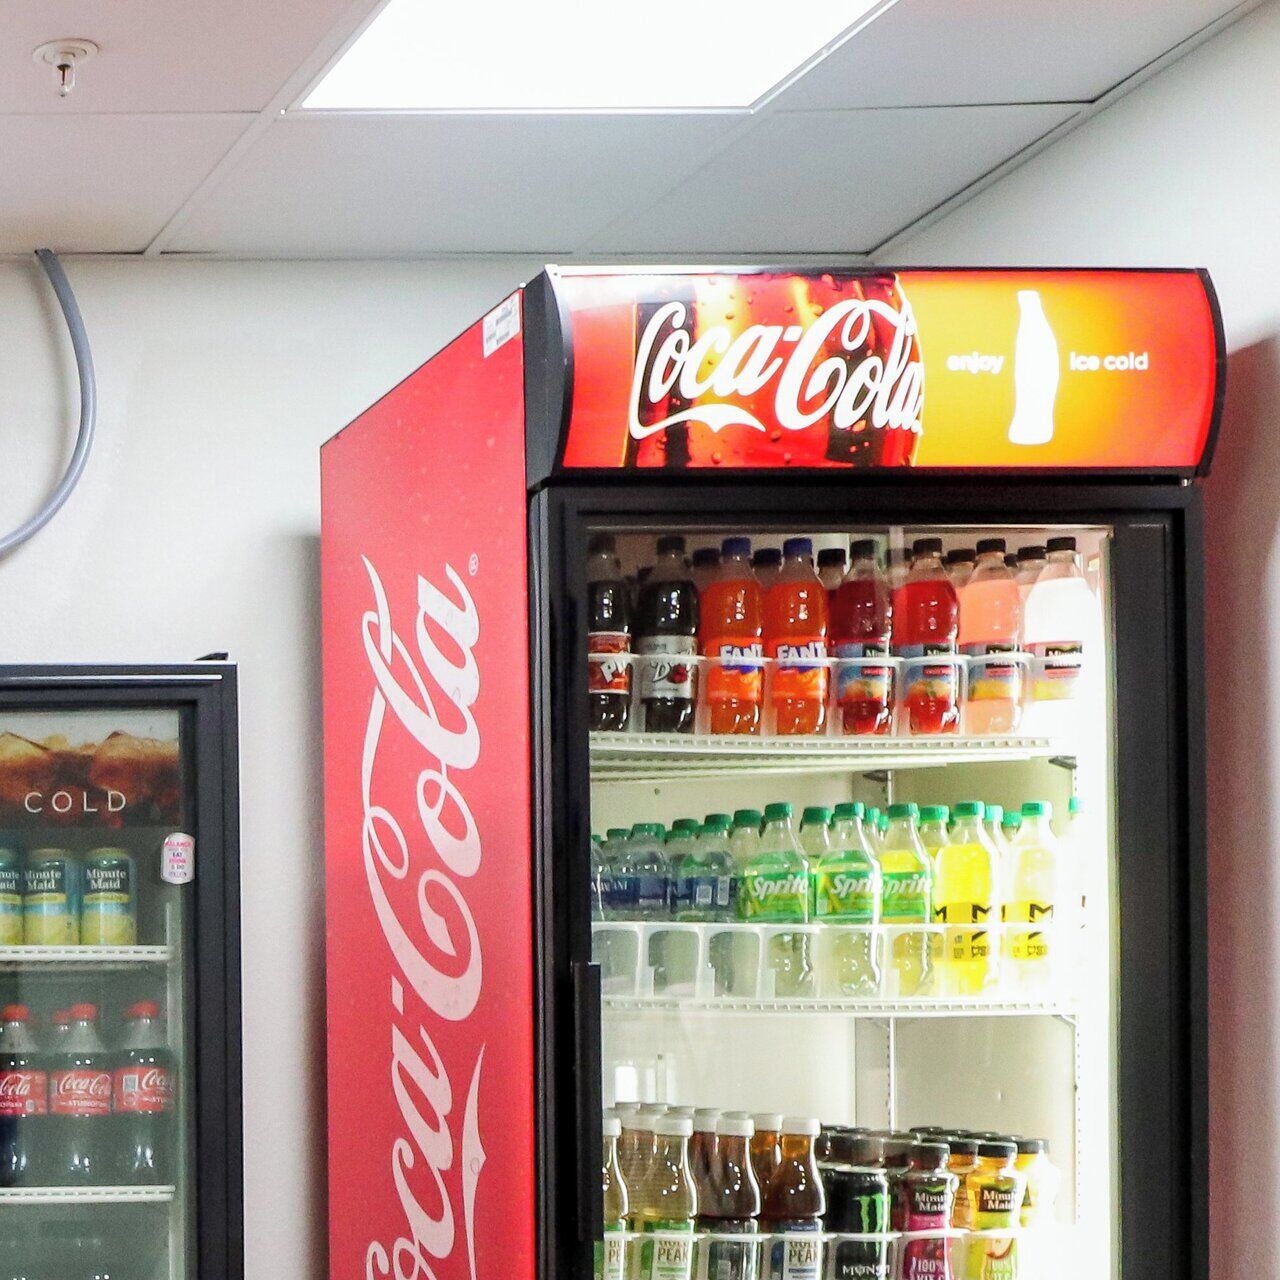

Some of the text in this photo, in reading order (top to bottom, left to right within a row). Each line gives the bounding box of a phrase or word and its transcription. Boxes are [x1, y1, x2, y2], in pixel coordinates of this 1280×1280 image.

[629, 298, 924, 440] Coca-Cola
[946, 351, 1005, 375] enjoy
[1069, 351, 1149, 371] ice cold
[719, 642, 763, 666] FANT
[776, 640, 828, 666] FANT
[24, 790, 127, 814] COLD
[27, 879, 56, 890] Maid
[86, 868, 127, 880] Minute
[91, 878, 121, 890] Maid
